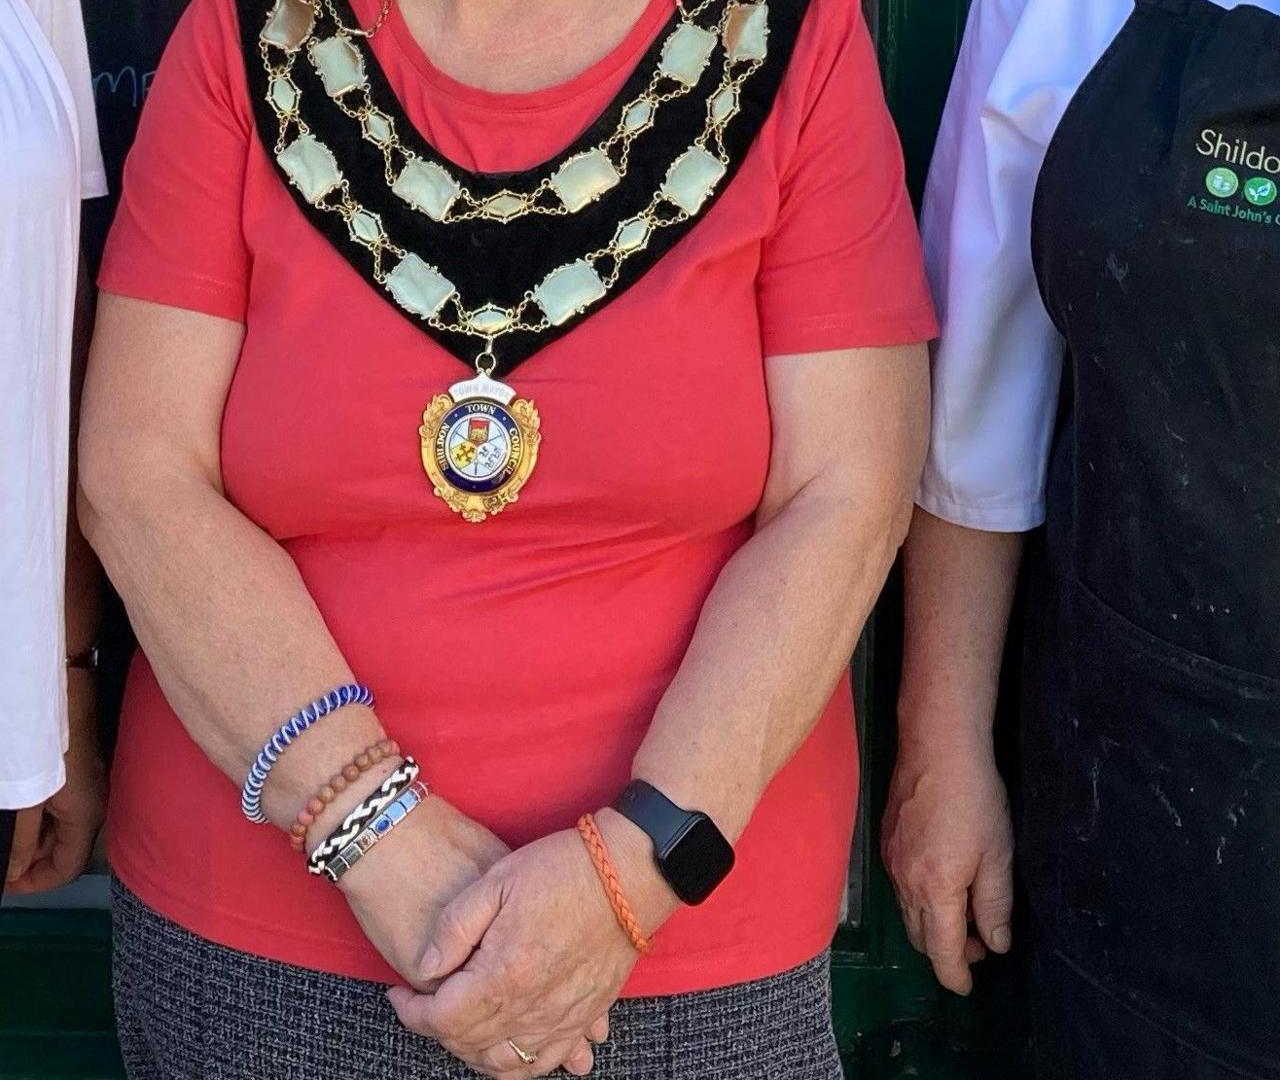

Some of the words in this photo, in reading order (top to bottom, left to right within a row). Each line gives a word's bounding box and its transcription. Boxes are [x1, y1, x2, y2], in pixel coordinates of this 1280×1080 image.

[1187, 195, 1197, 208] A
[1198, 198, 1231, 217] Saint
[1231, 205, 1272, 224] John's
[465, 403, 497, 416] TOWN
